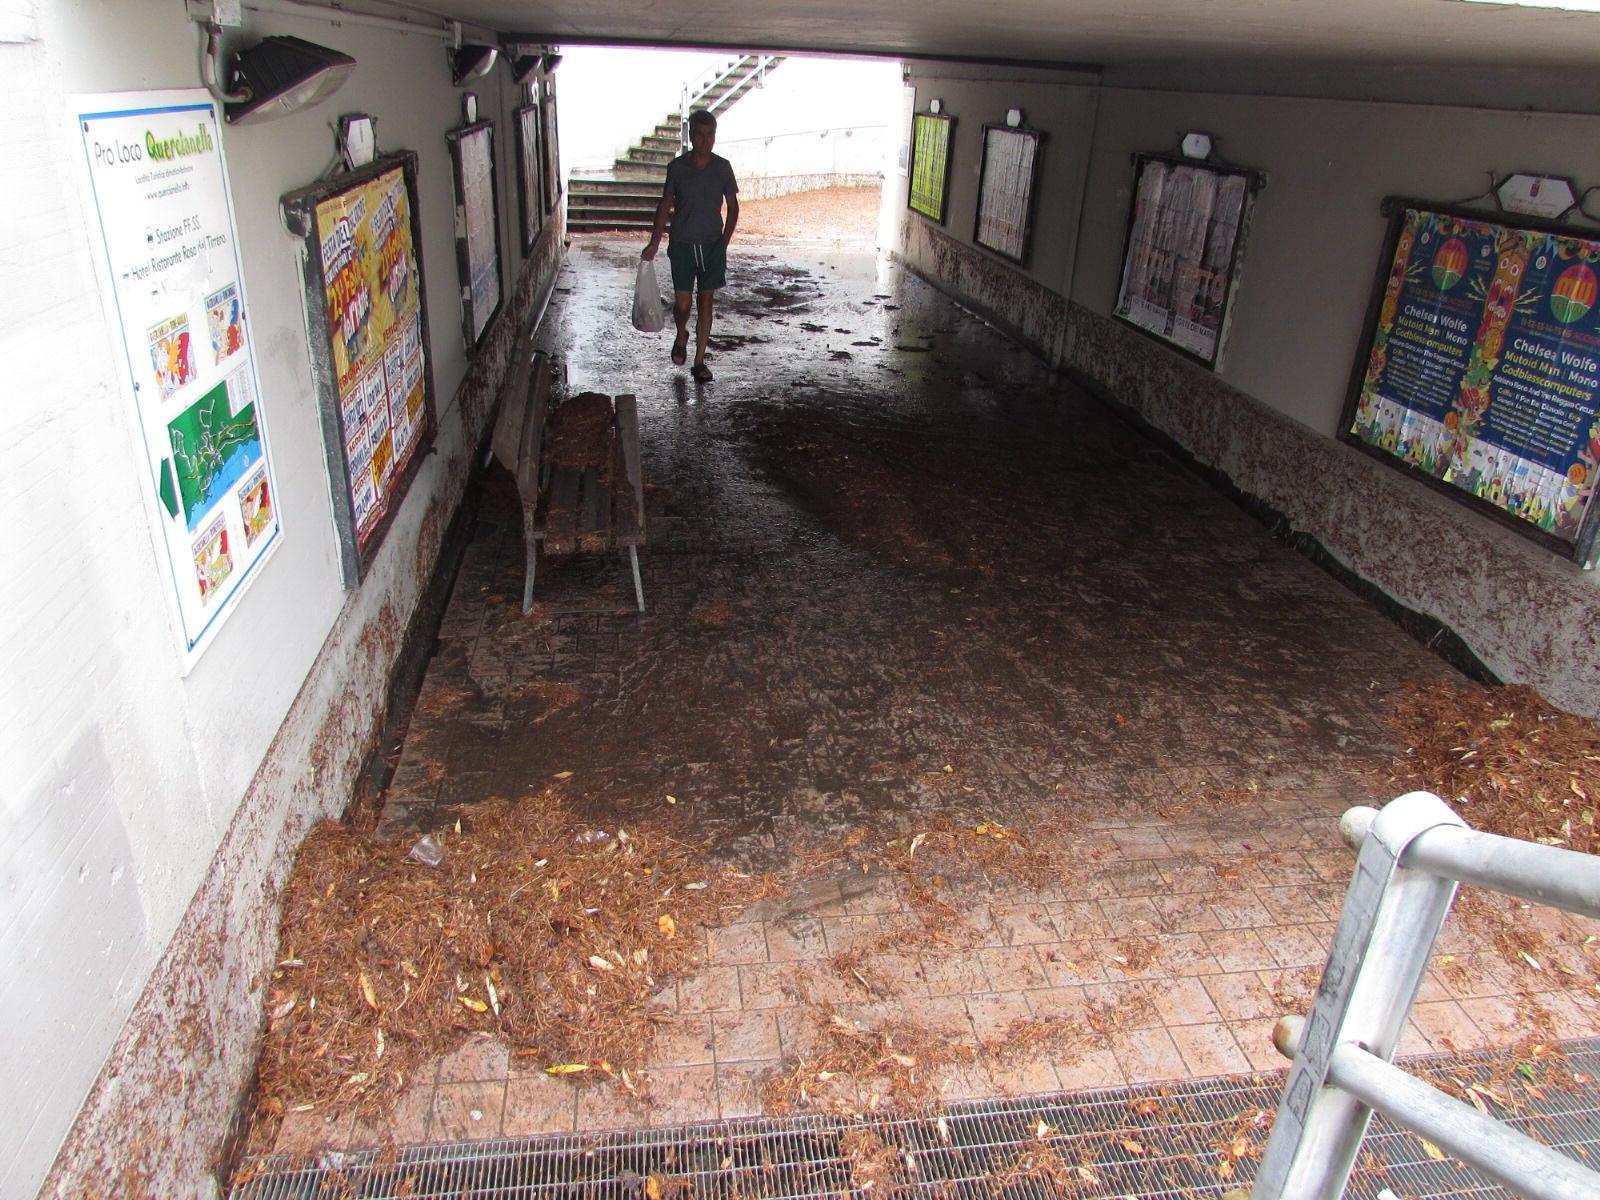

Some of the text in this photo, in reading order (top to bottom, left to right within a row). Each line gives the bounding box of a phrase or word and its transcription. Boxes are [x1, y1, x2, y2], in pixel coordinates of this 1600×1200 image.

[94, 122, 213, 167] Pro Loco Quercianella
[156, 226, 183, 244] Stazione
[131, 261, 151, 281] Hotel
[151, 252, 182, 272] Ristorante
[182, 245, 197, 259] Rosa
[206, 234, 226, 249] Tirreno
[1398, 316, 1424, 331] Mutoid
[1446, 331, 1468, 346] Mono
[1404, 305, 1468, 332] Chelsea Wolfe
[1395, 328, 1464, 357] Godblesscomputers
[1513, 339, 1557, 360] Chelsea
[1561, 352, 1597, 373] Wolfe
[339, 355, 368, 391] ERIGNANO
[1501, 364, 1592, 400] Godblesscomputers
[1504, 351, 1537, 369] Mutoid
[1568, 371, 1598, 388] Mono
